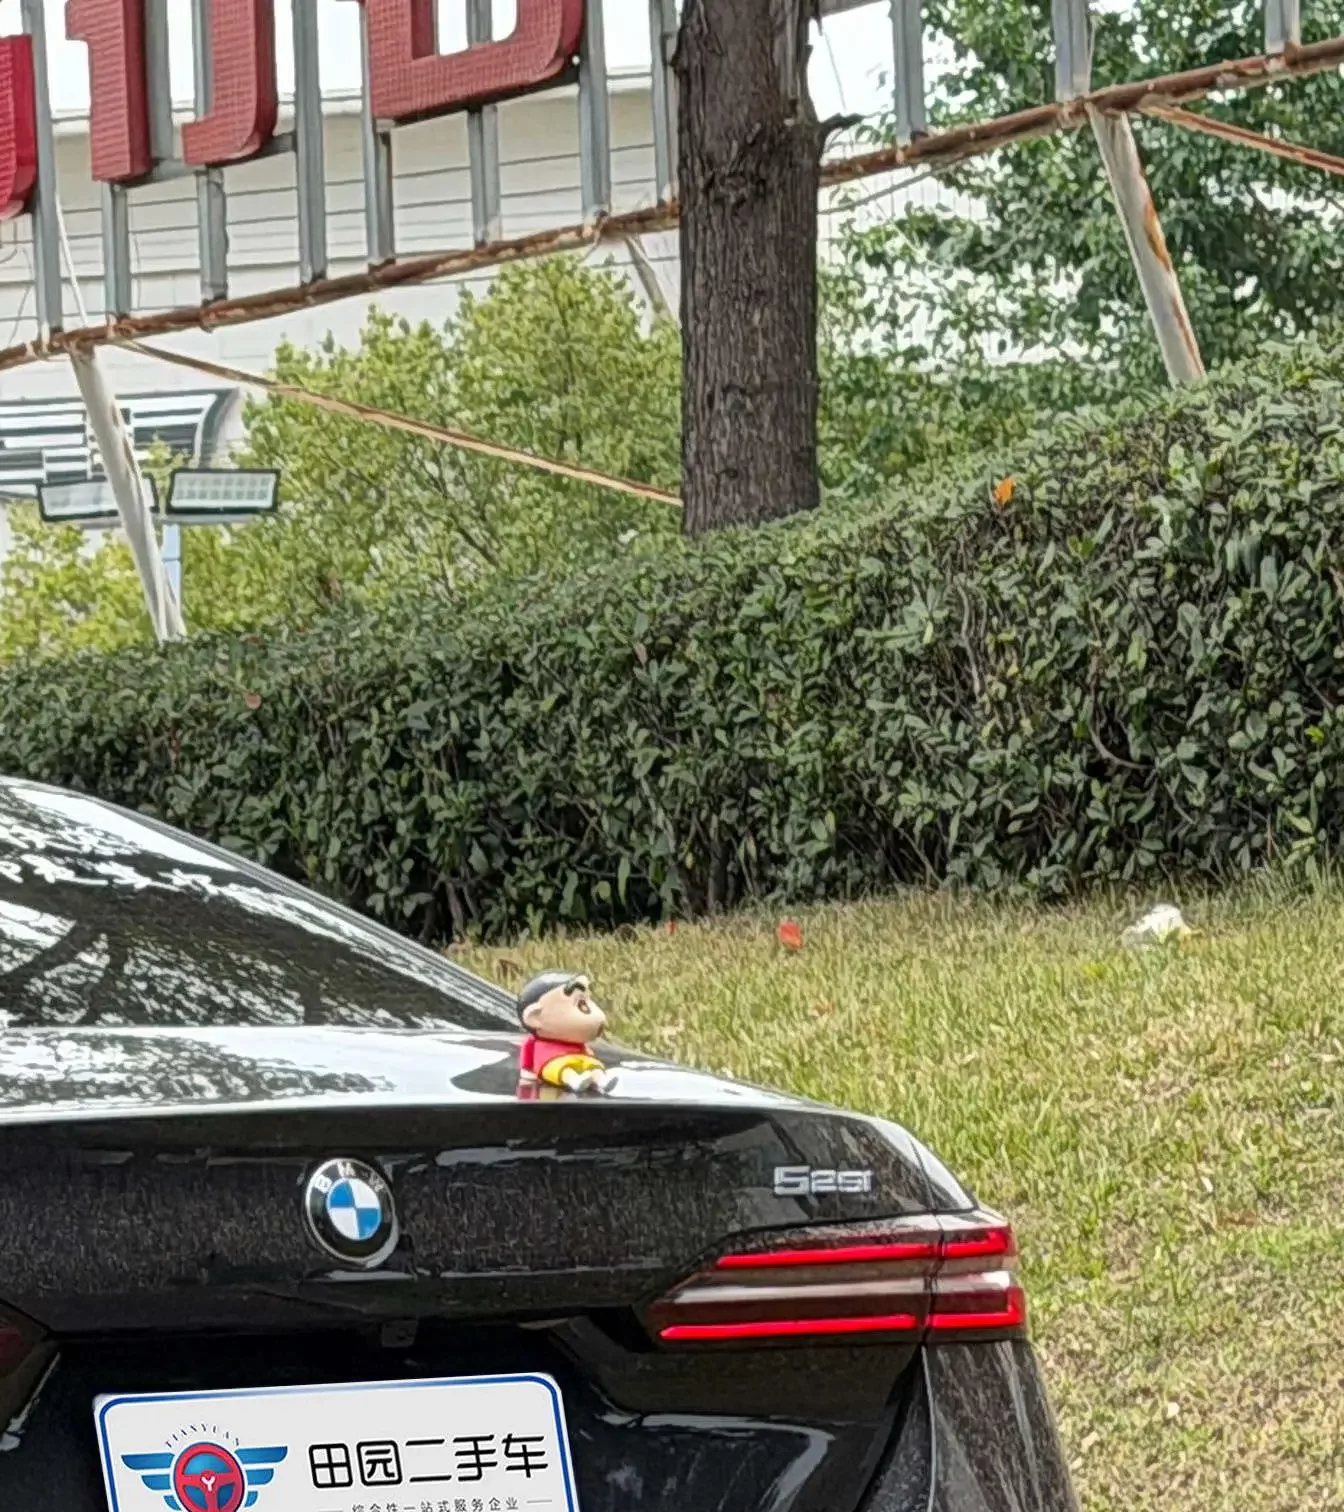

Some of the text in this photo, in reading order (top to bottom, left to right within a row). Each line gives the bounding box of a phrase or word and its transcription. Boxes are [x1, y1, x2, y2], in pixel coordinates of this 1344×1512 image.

[308, 1433, 549, 1489] 田园二手车
